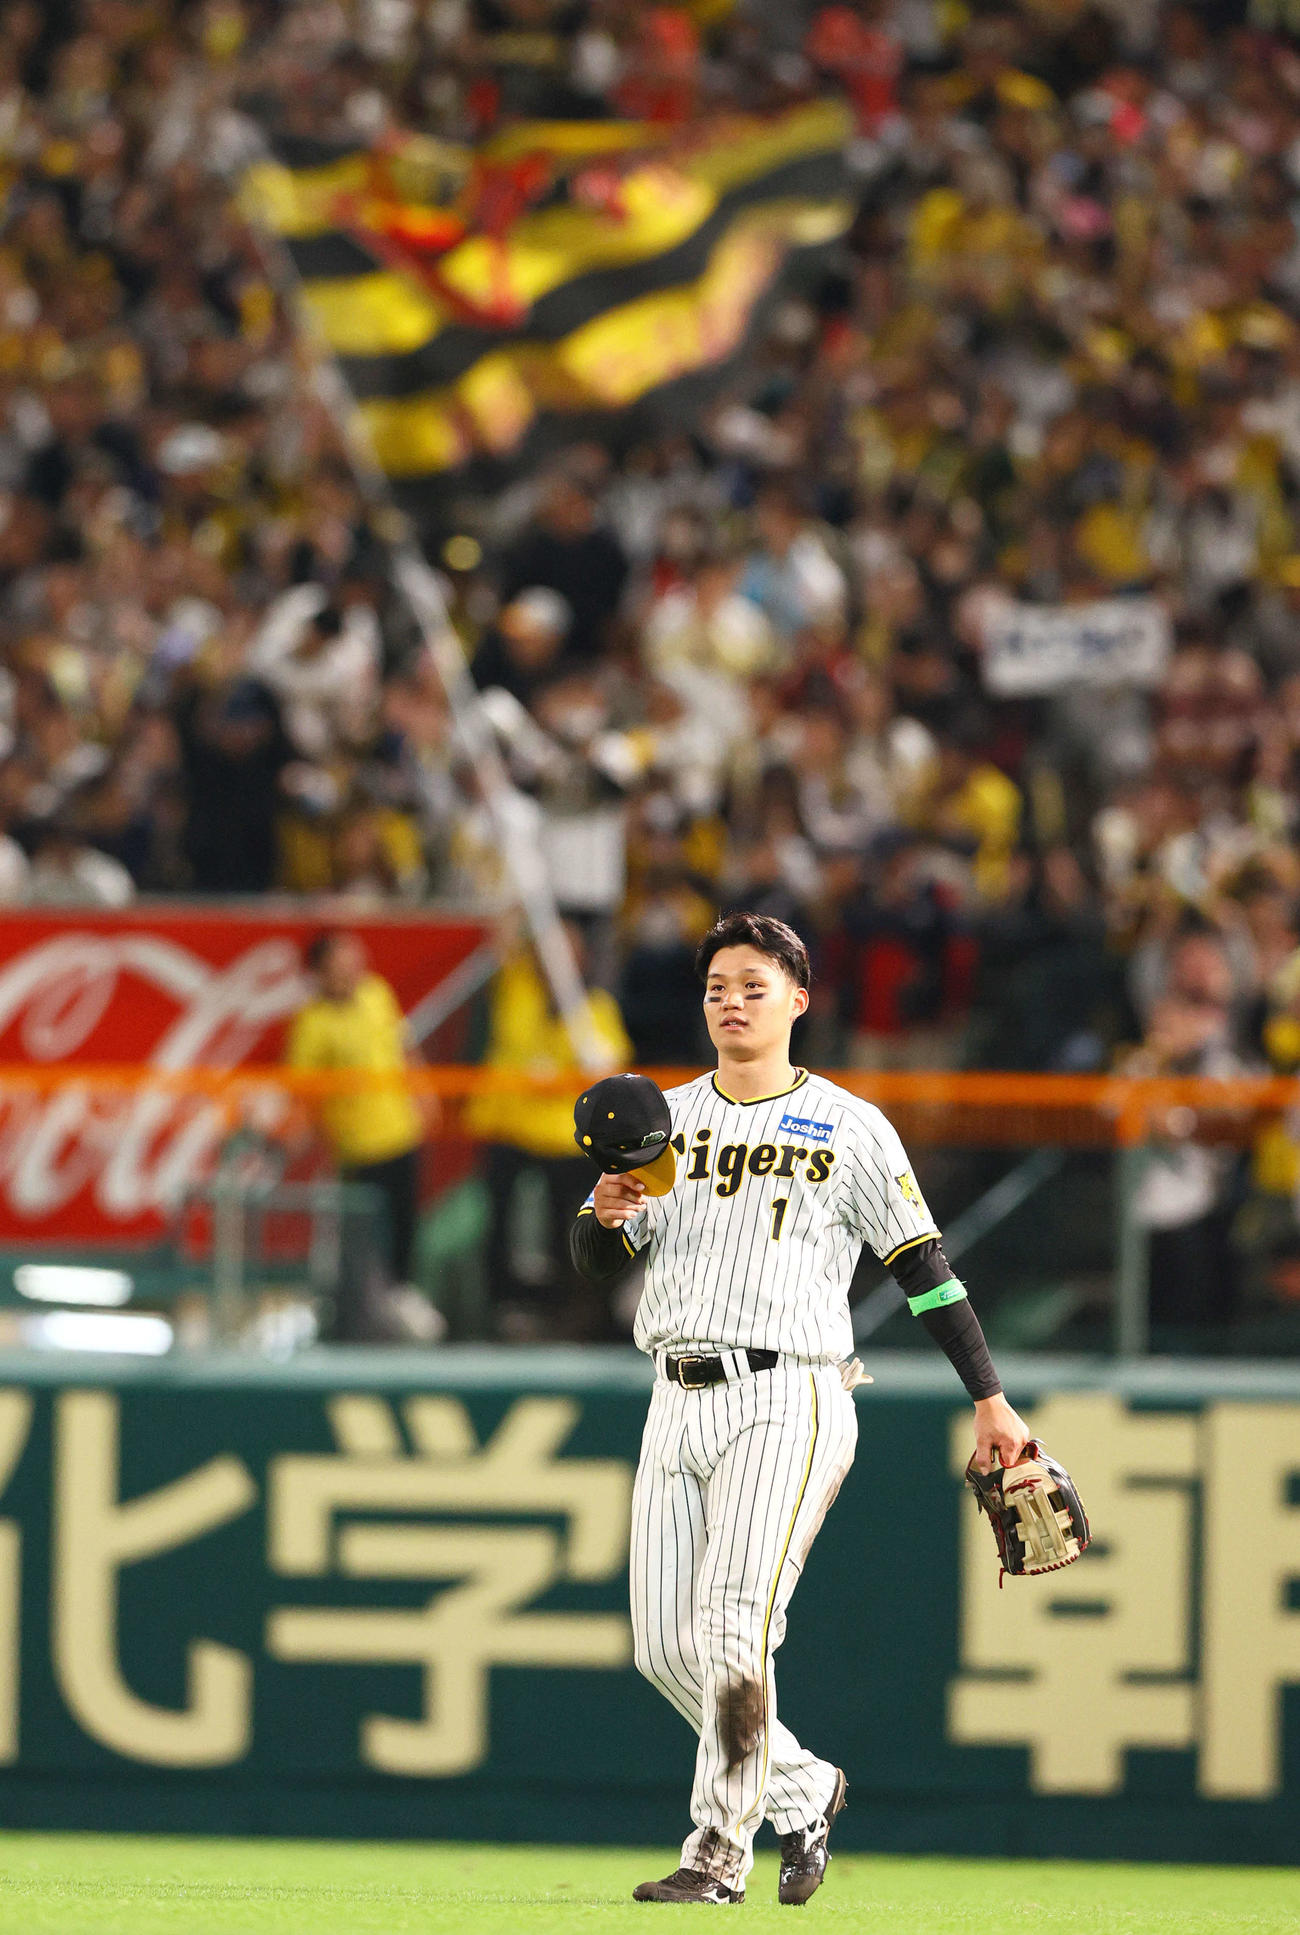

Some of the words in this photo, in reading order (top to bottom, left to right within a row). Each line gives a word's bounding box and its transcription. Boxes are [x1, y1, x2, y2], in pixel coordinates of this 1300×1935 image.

[780, 1117, 832, 1140] Joshin
[669, 1128, 836, 1199] igers
[770, 1197, 789, 1243] 1
